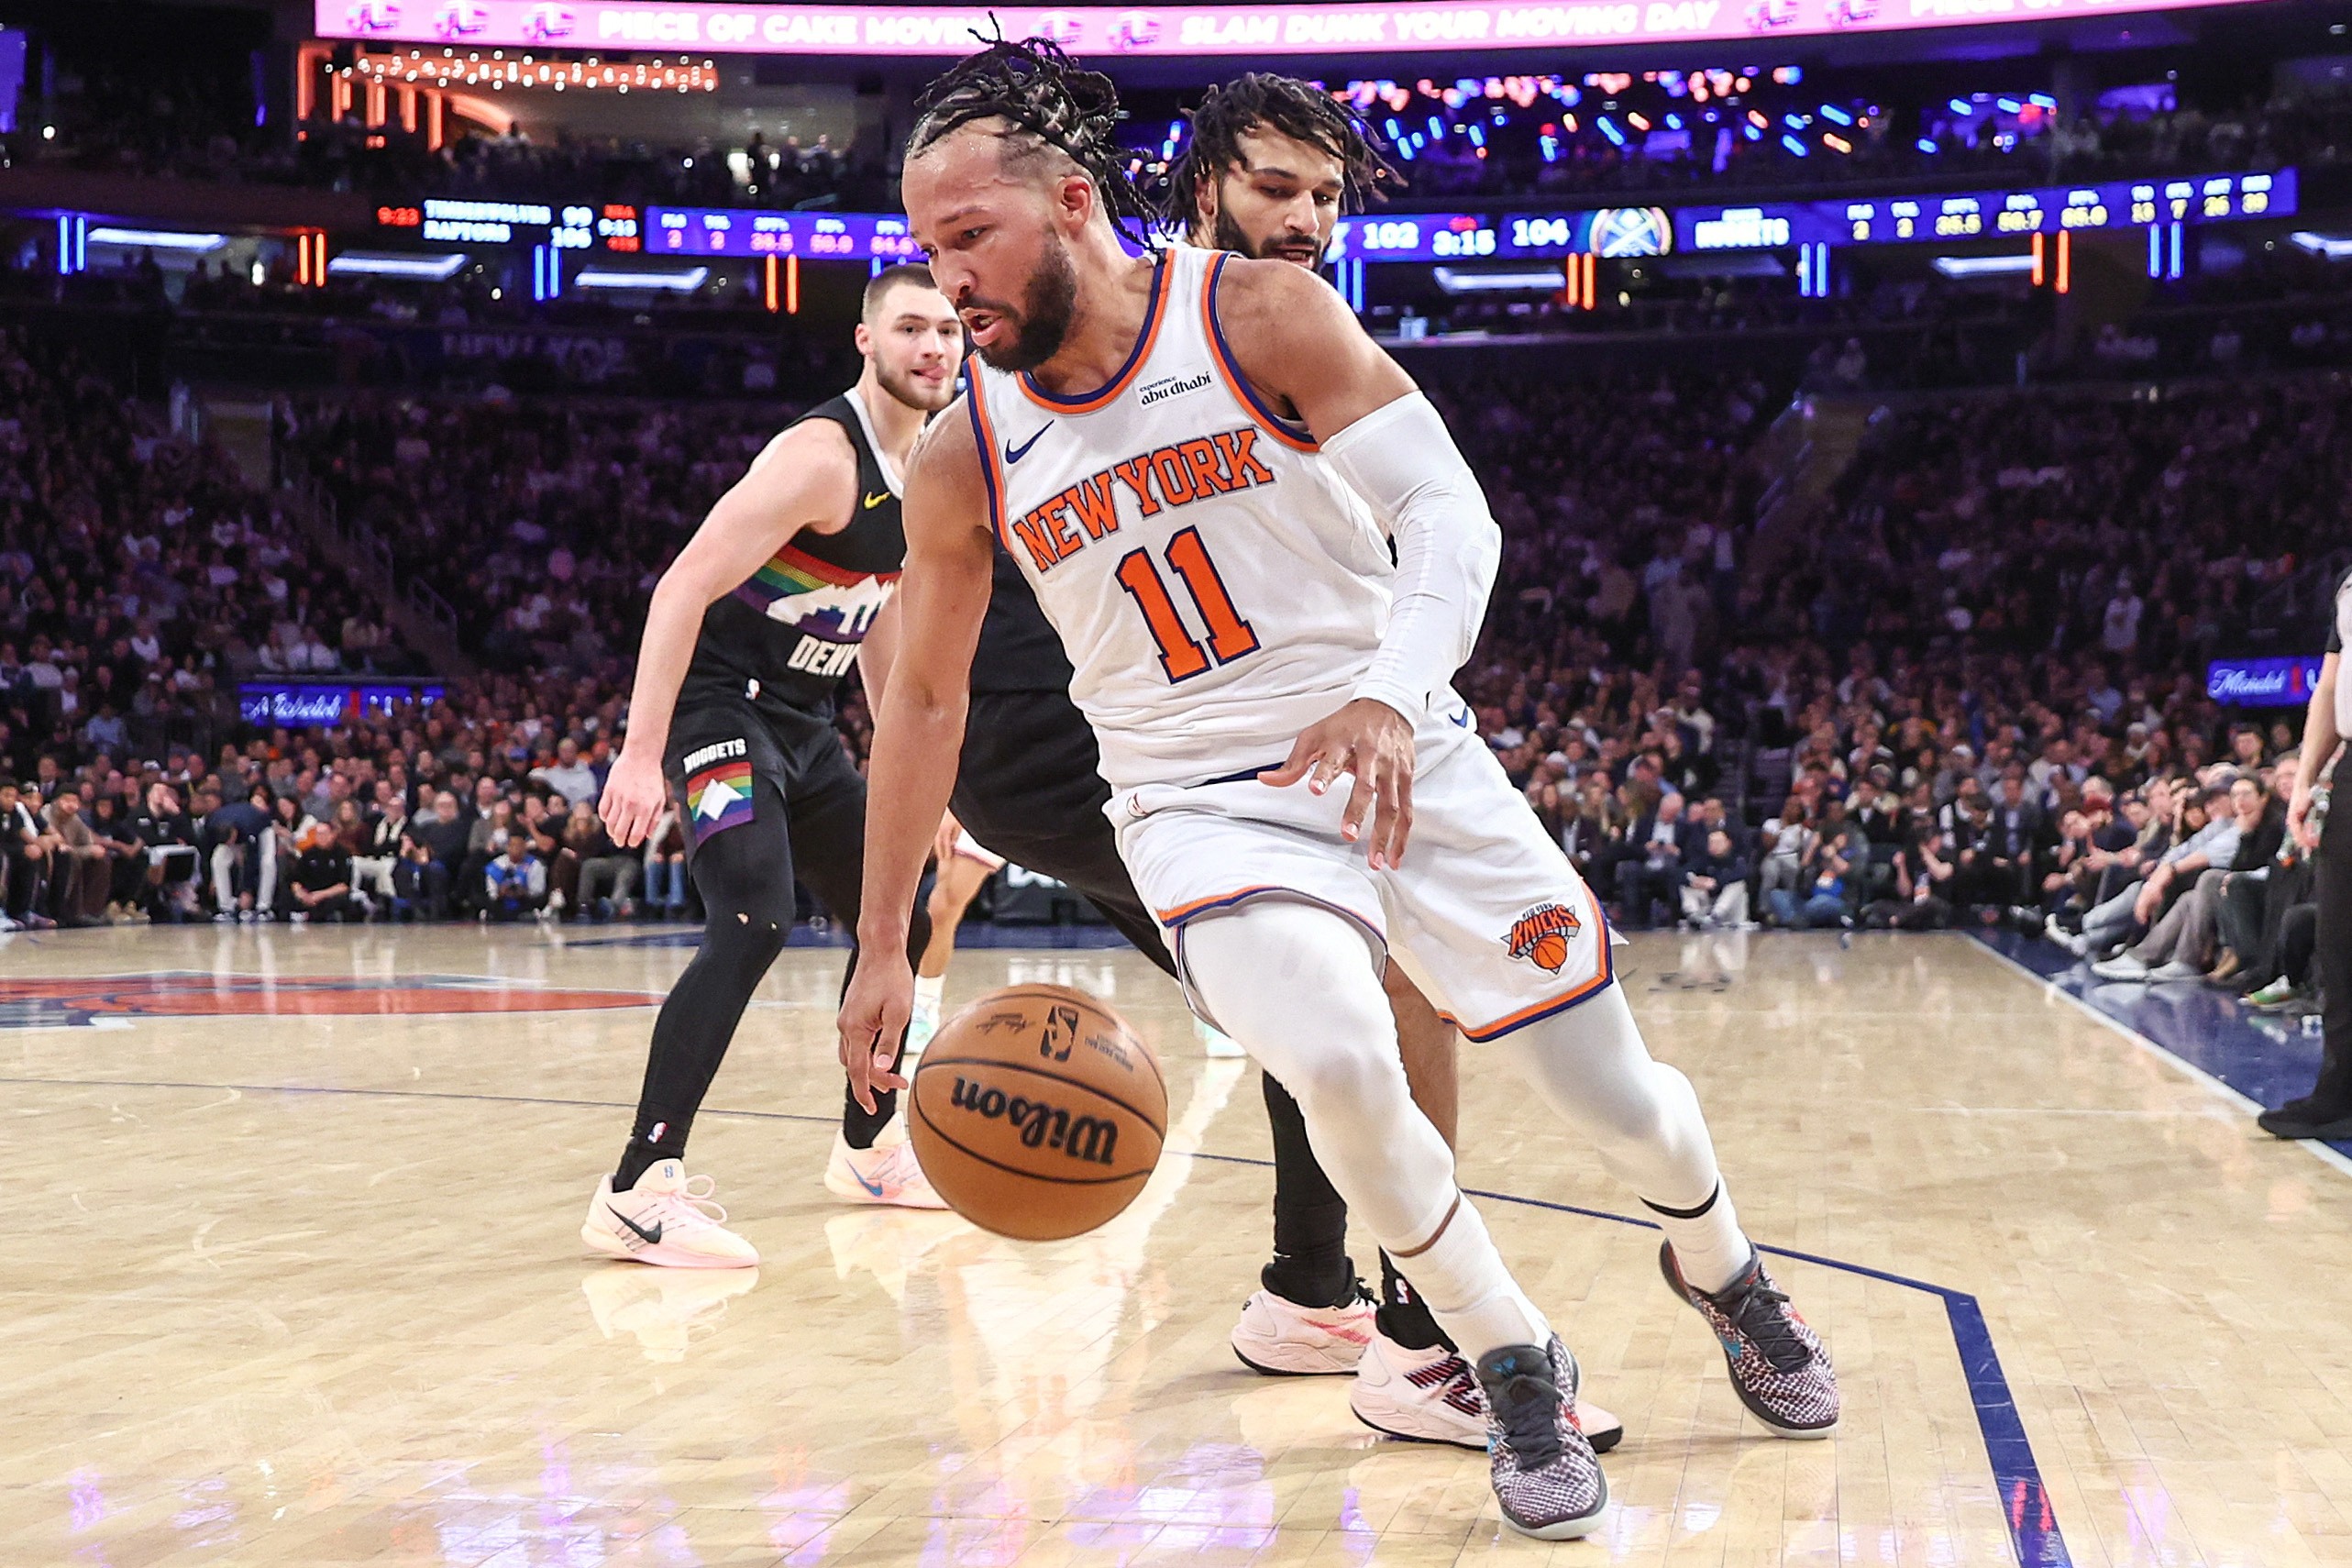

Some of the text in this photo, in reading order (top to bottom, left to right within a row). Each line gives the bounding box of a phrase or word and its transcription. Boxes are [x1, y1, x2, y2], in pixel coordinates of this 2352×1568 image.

[599, 11, 1006, 46] PIECE OF CAKE MOVING
[1179, 1, 1720, 45] SLAM DUNK YOUR MOVING DAY
[561, 205, 593, 227] 99
[2166, 198, 2189, 219] 7
[423, 219, 512, 242] RAPTORS
[551, 226, 592, 248] 106
[668, 229, 682, 248] 2
[710, 231, 725, 250] 2
[1363, 221, 1419, 249] 102
[1431, 228, 1496, 256] 3:15
[1512, 218, 1571, 247] 104
[1140, 376, 1177, 392] experience
[1142, 370, 1212, 405] abu dhabi
[1010, 425, 1276, 575] NEW YORK
[1114, 524, 1262, 685] 11
[787, 634, 861, 678] DENV
[682, 737, 747, 774] NUGGETS
[1509, 904, 1582, 955] KNICKS
[950, 1077, 1119, 1165] Wilson
